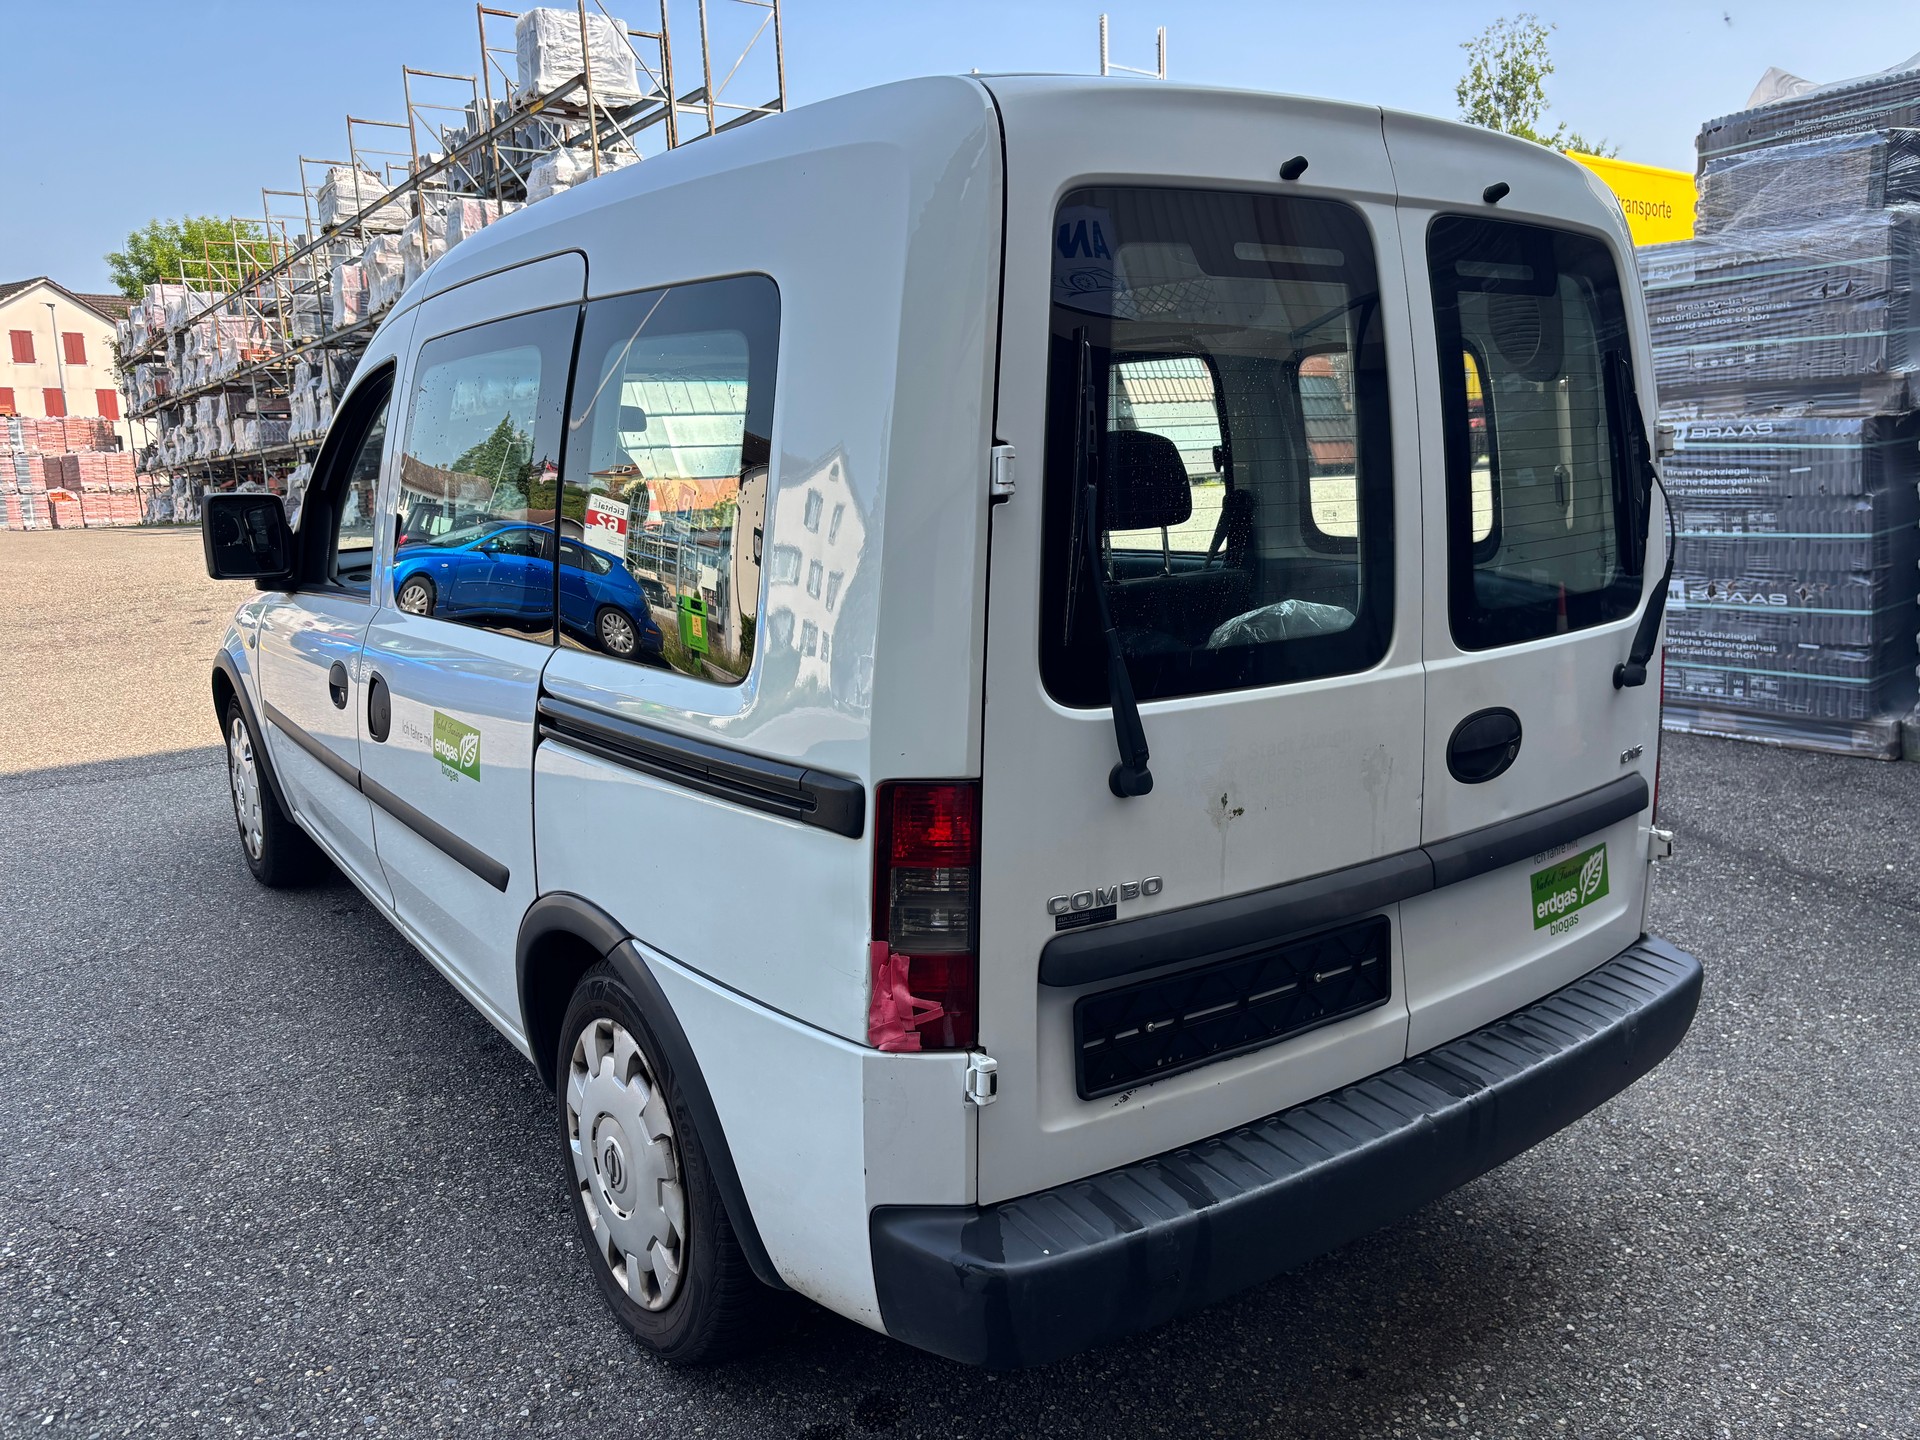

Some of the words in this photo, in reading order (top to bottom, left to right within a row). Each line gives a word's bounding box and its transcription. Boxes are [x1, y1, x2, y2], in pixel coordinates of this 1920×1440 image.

[1656, 312, 1711, 324] Natürliche
[1712, 301, 1792, 316] Geborgenheit
[1675, 321, 1696, 331] und
[1697, 318, 1733, 328] zeitlos
[1736, 313, 1770, 323] schön
[1689, 422, 1774, 439] BRAAS
[1695, 467, 1750, 477] Dachziegel
[1699, 476, 1771, 487] Geborgenheit
[1665, 488, 1685, 496] und
[1686, 487, 1719, 496] zeitlos
[1720, 486, 1752, 496] schön
[1668, 628, 1697, 637] Braas
[1698, 630, 1757, 642] Dachziegel
[1667, 647, 1688, 655] und
[1724, 650, 1757, 660] schön
[1703, 639, 1778, 653] Geborgenheit
[435, 738, 459, 762] erdgas
[441, 762, 459, 783] biogas
[1046, 875, 1163, 916] COMBO
[1536, 887, 1578, 919] erdgas
[1549, 913, 1579, 936] biogas
